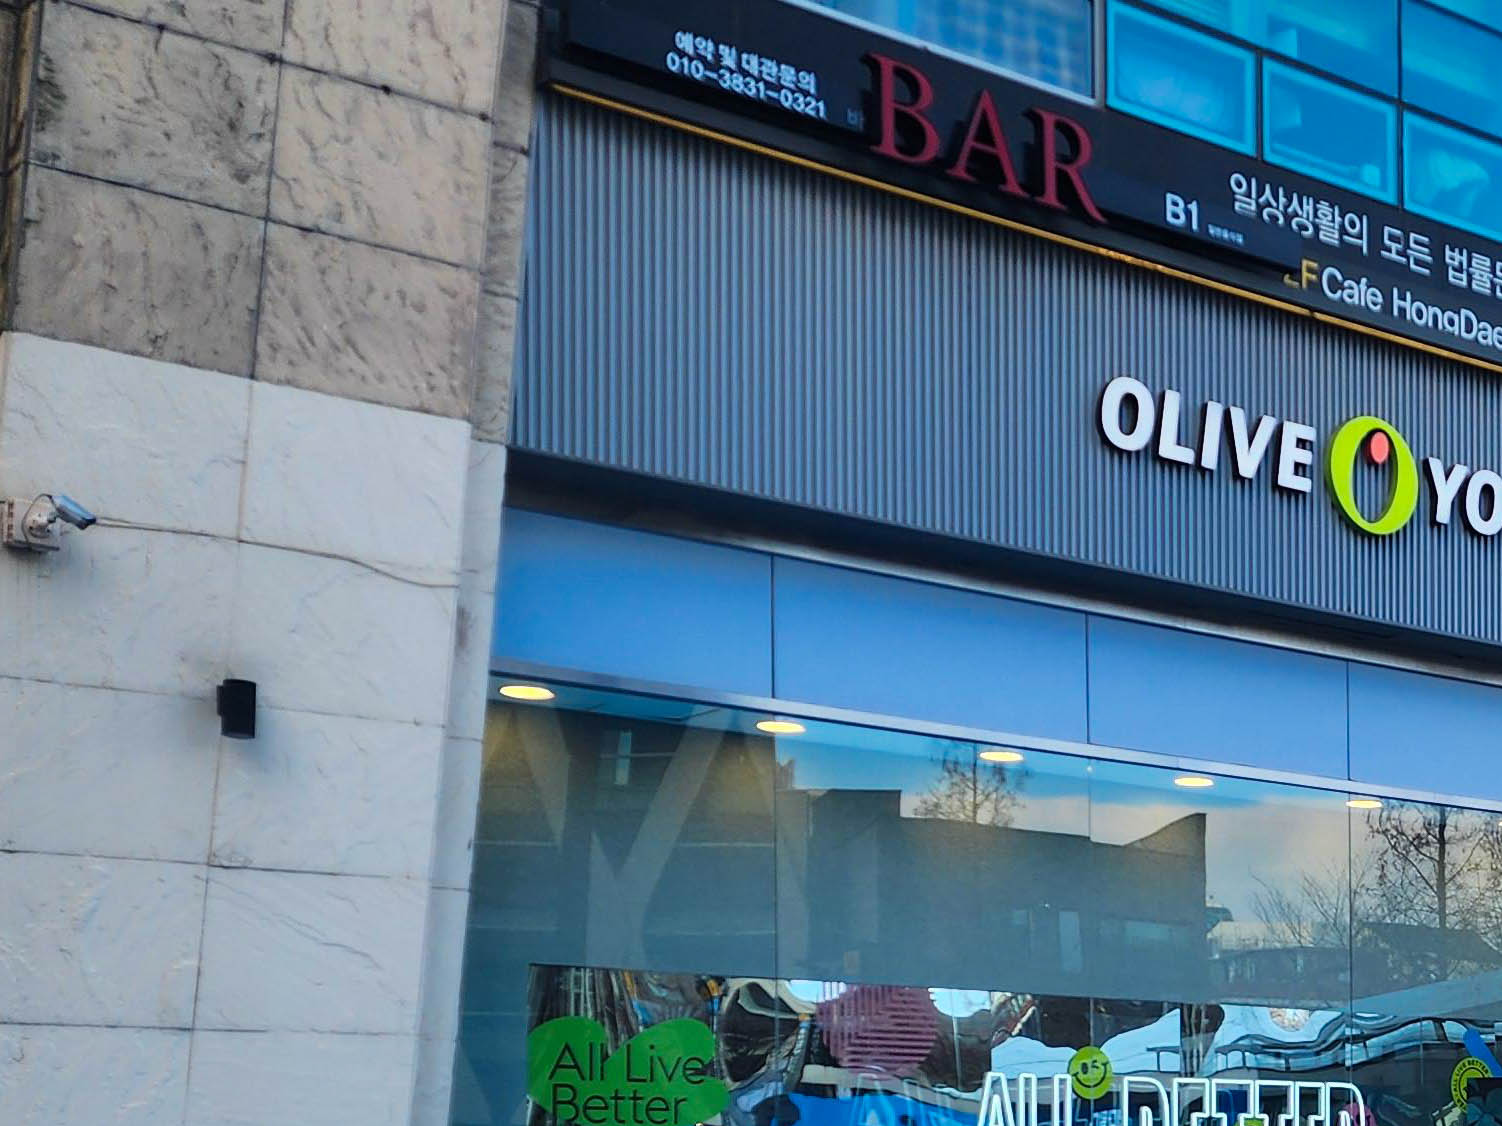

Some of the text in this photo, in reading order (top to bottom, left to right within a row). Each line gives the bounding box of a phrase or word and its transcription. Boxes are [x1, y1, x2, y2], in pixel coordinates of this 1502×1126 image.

[666, 51, 827, 118] 010-3831-0321
[868, 52, 1107, 221] BAR
[1165, 192, 1199, 233] B1
[1229, 172, 1369, 257] 일상생활의
[1380, 225, 1434, 276] 모든
[1321, 266, 1384, 313] Cafe
[1100, 375, 1317, 495] OLIVE
[548, 1042, 706, 1086] All Live
[551, 1082, 689, 1126] Better
